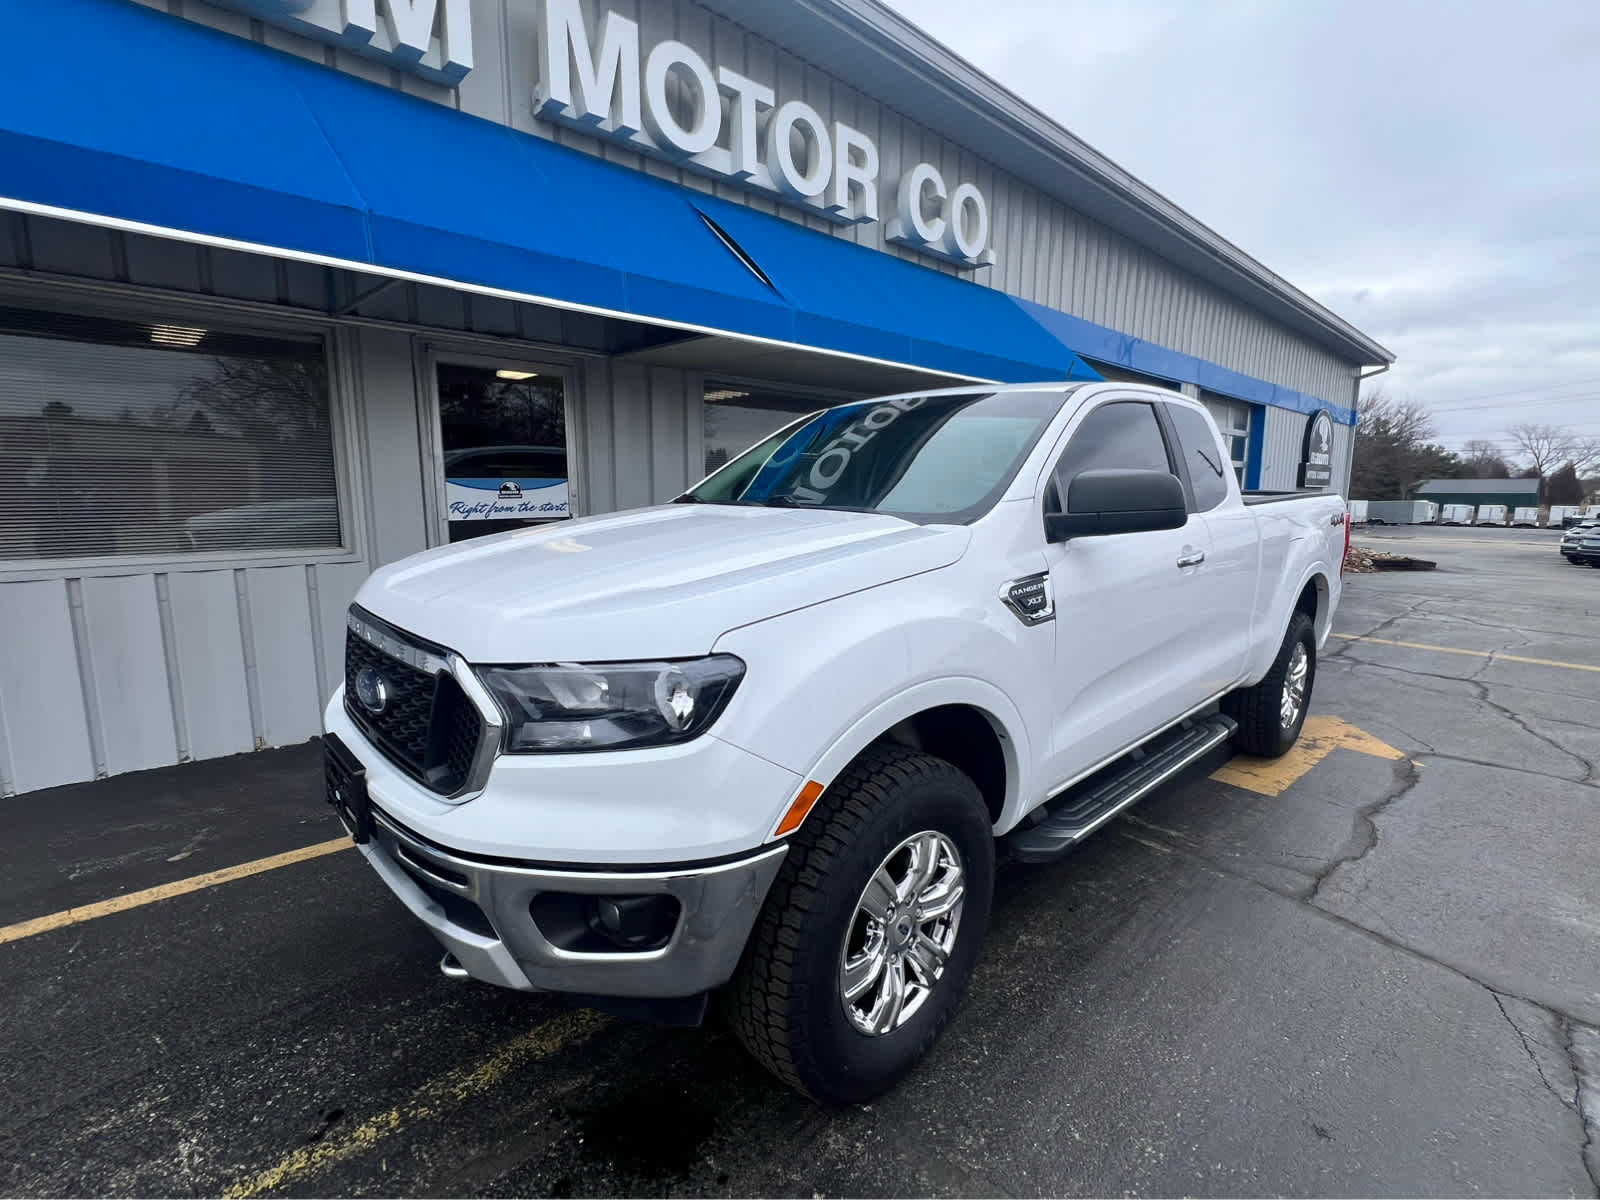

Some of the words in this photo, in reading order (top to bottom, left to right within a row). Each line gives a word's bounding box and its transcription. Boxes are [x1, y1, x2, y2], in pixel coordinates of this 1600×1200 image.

[544, 0, 880, 222] MOTOR
[449, 501, 489, 519] Right
[484, 501, 516, 519] from
[517, 501, 537, 512] the
[1011, 583, 1043, 597] RANGER
